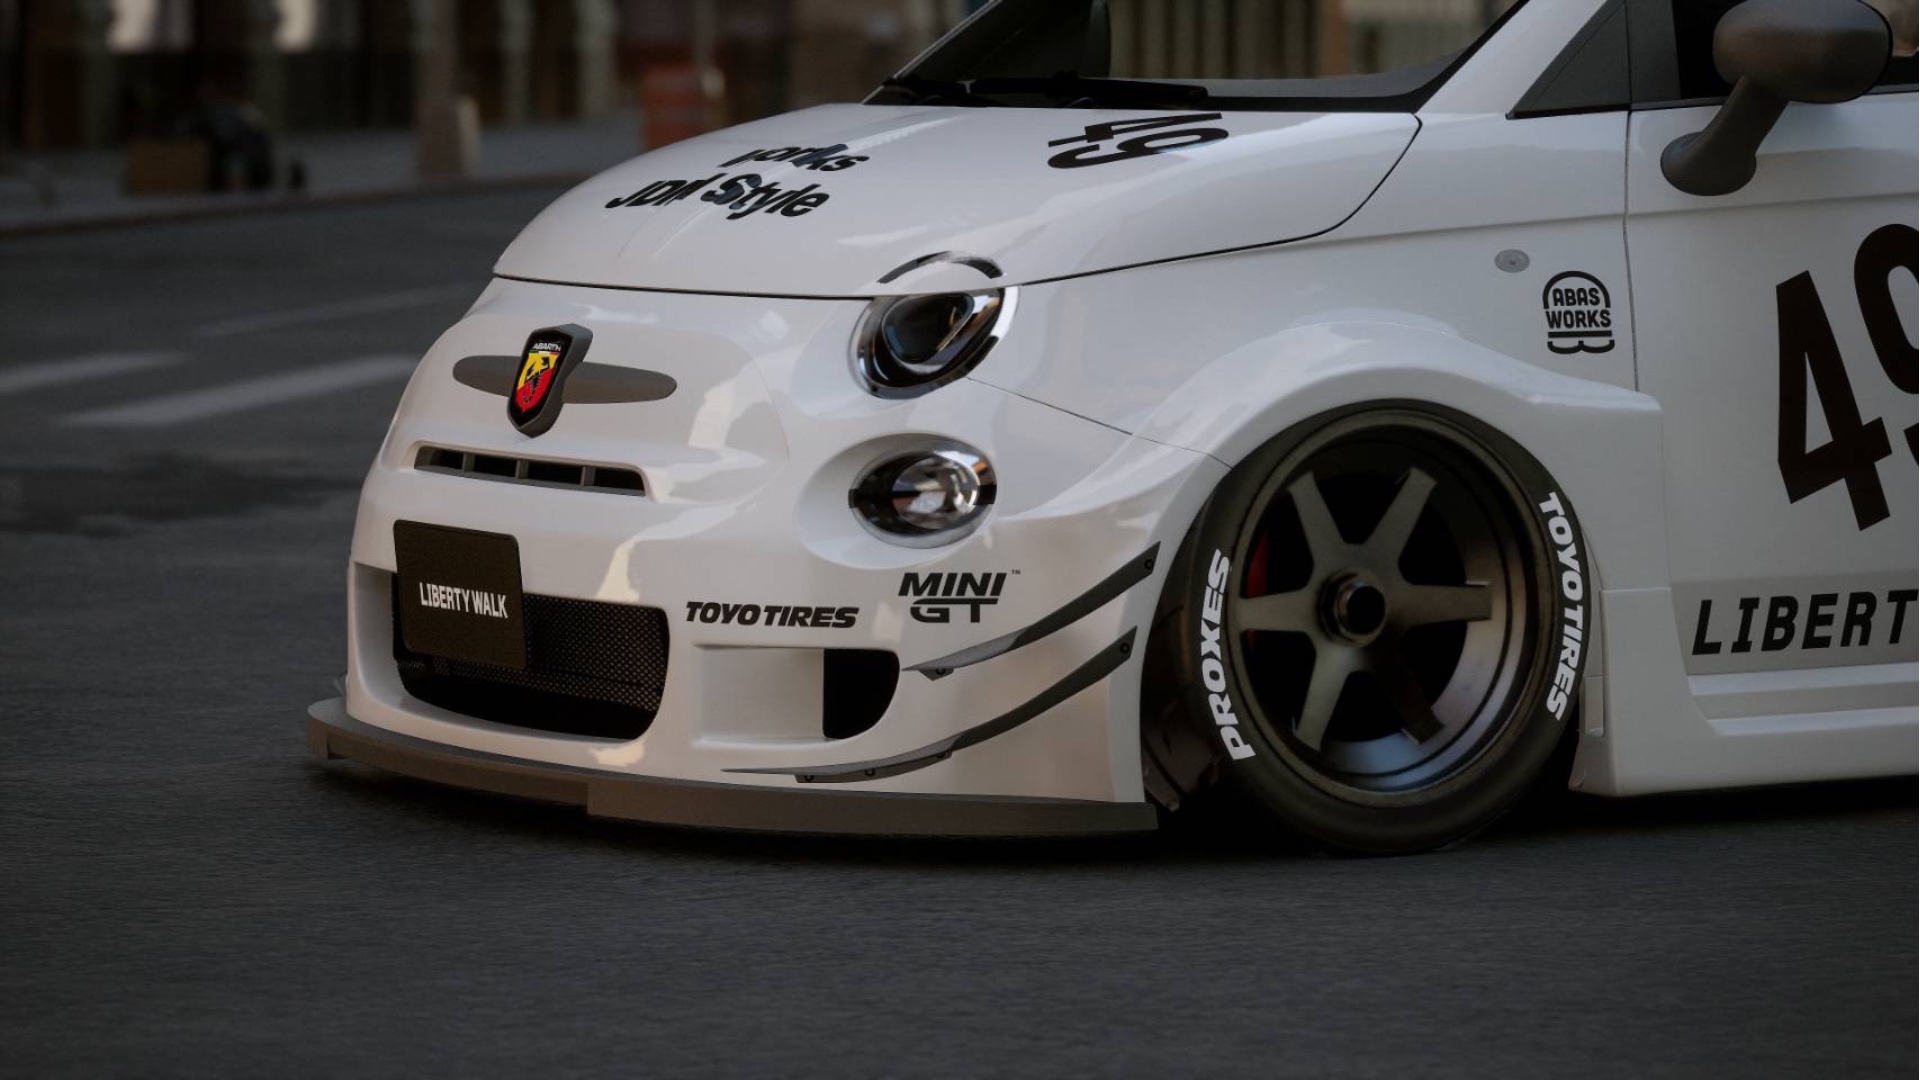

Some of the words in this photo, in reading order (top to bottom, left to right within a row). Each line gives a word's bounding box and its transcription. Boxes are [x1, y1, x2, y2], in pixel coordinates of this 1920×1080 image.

[1048, 112, 1229, 168] 49
[700, 173, 830, 220] Style
[1545, 309, 1612, 329] WORKS
[1552, 287, 1600, 306] ABAS
[1775, 223, 1919, 531] 49
[1539, 492, 1583, 601] TOYO
[419, 582, 470, 612] LIBERTY
[471, 589, 508, 619] WALK
[898, 572, 1007, 597] MINI
[683, 601, 762, 626] TOYO
[763, 605, 860, 629] TIRES
[910, 598, 999, 623] GT
[1692, 588, 1919, 656] LIBERT
[1201, 548, 1256, 760] PROXES
[1546, 604, 1583, 721] TIRES
